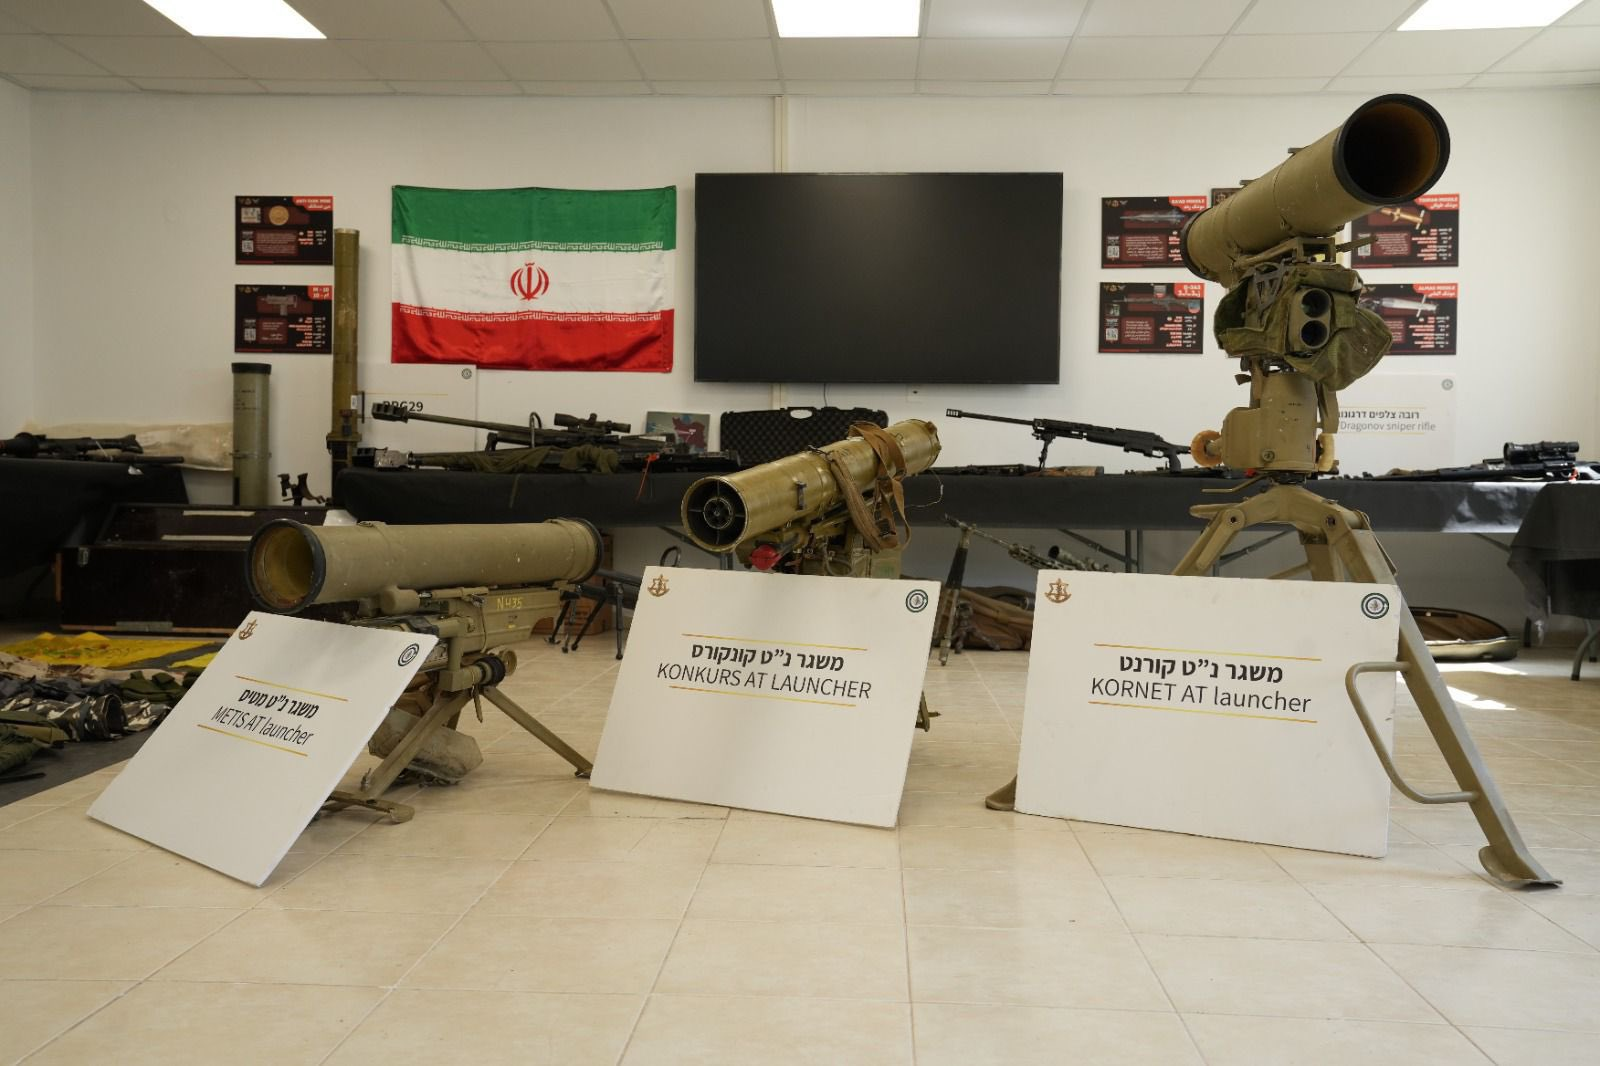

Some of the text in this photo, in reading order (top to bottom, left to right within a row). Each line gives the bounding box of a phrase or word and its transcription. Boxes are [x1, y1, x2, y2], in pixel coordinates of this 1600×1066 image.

[1339, 410, 1420, 419] רובה צלפים דרגונו
[1340, 421, 1437, 432] Dragonov sniper rifle
[691, 644, 757, 667] קונקורס
[797, 653, 845, 671] משגר
[1120, 655, 1176, 679] קורנט
[1225, 663, 1283, 683] משגר
[657, 663, 872, 699] KONKURS AT LAUNCHER
[238, 689, 268, 707] מטיס
[1091, 677, 1312, 713] KORNET AT launcher
[287, 700, 319, 719] משגר
[211, 706, 315, 746] METIS AT launcher
